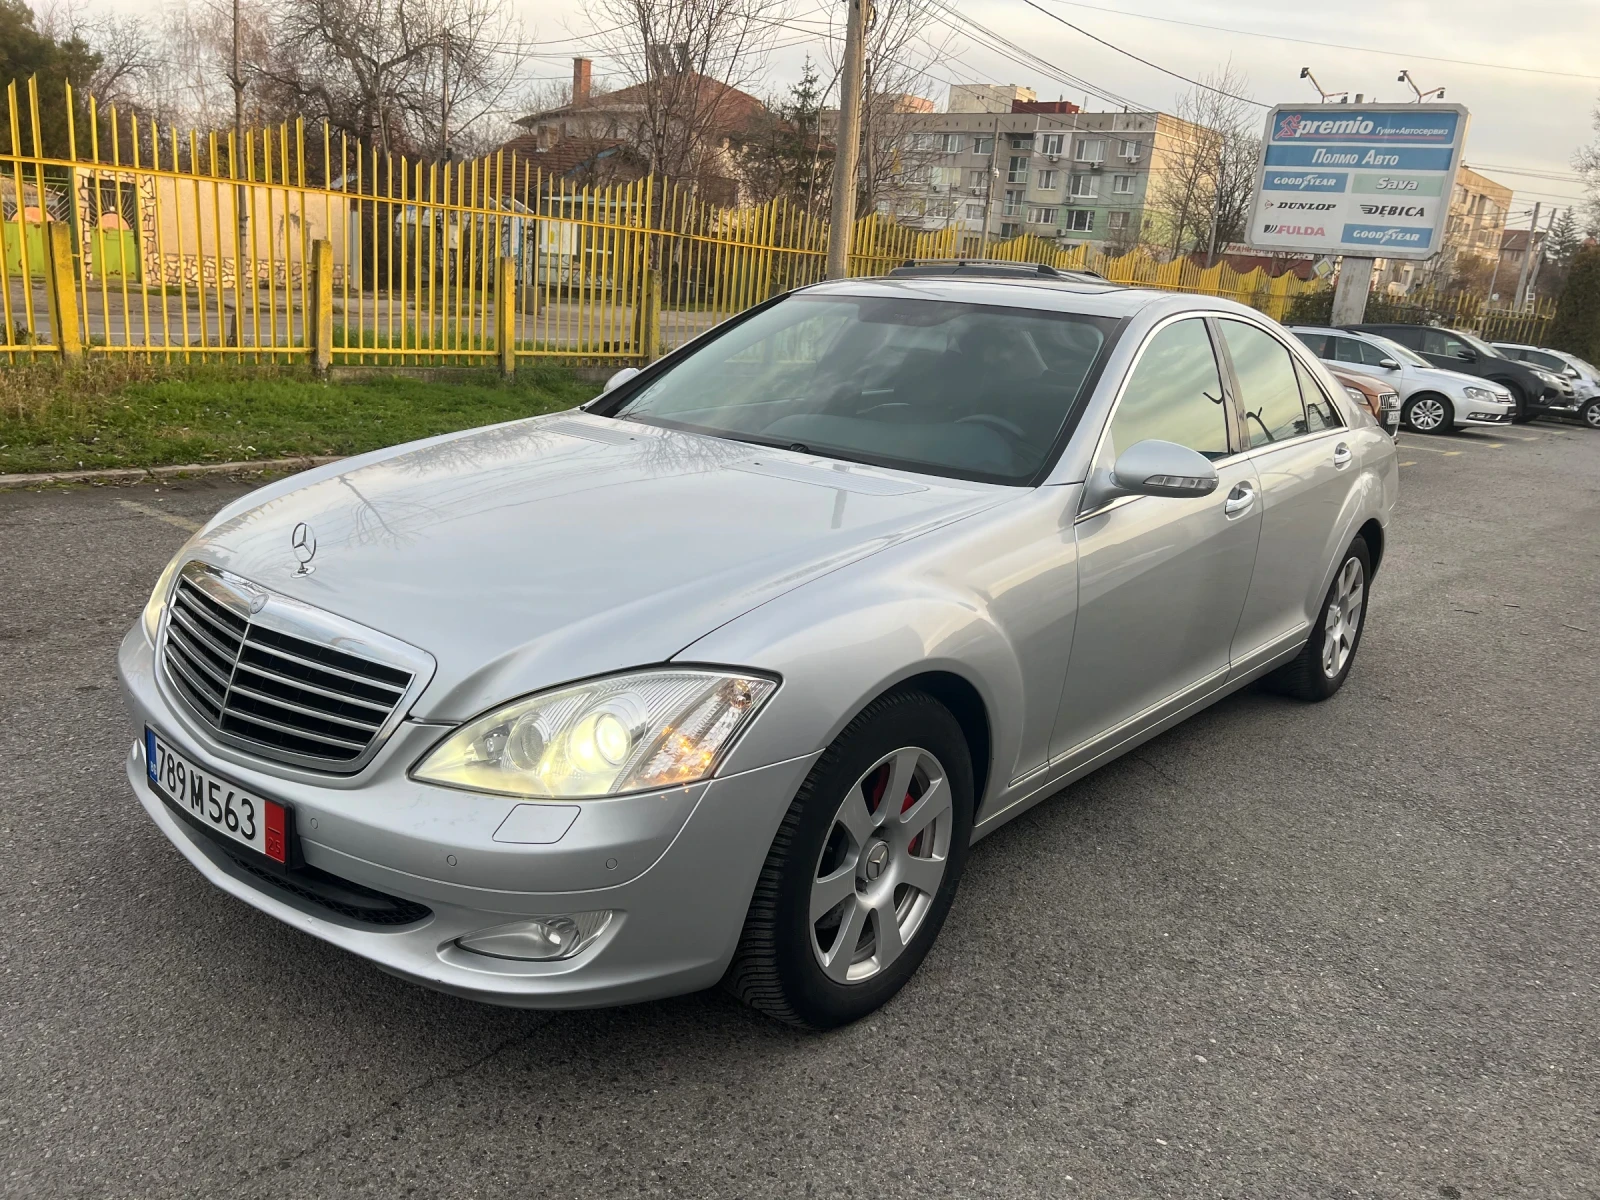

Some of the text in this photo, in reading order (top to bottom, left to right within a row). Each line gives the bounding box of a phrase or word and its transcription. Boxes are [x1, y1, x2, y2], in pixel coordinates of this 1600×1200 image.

[1296, 116, 1374, 138] premio
[1312, 148, 1399, 166] Полмо Авто
[1376, 177, 1419, 191] Sava
[1277, 201, 1337, 211] DUNLOP
[1275, 224, 1326, 237] FULDA
[268, 836, 281, 855] 25
